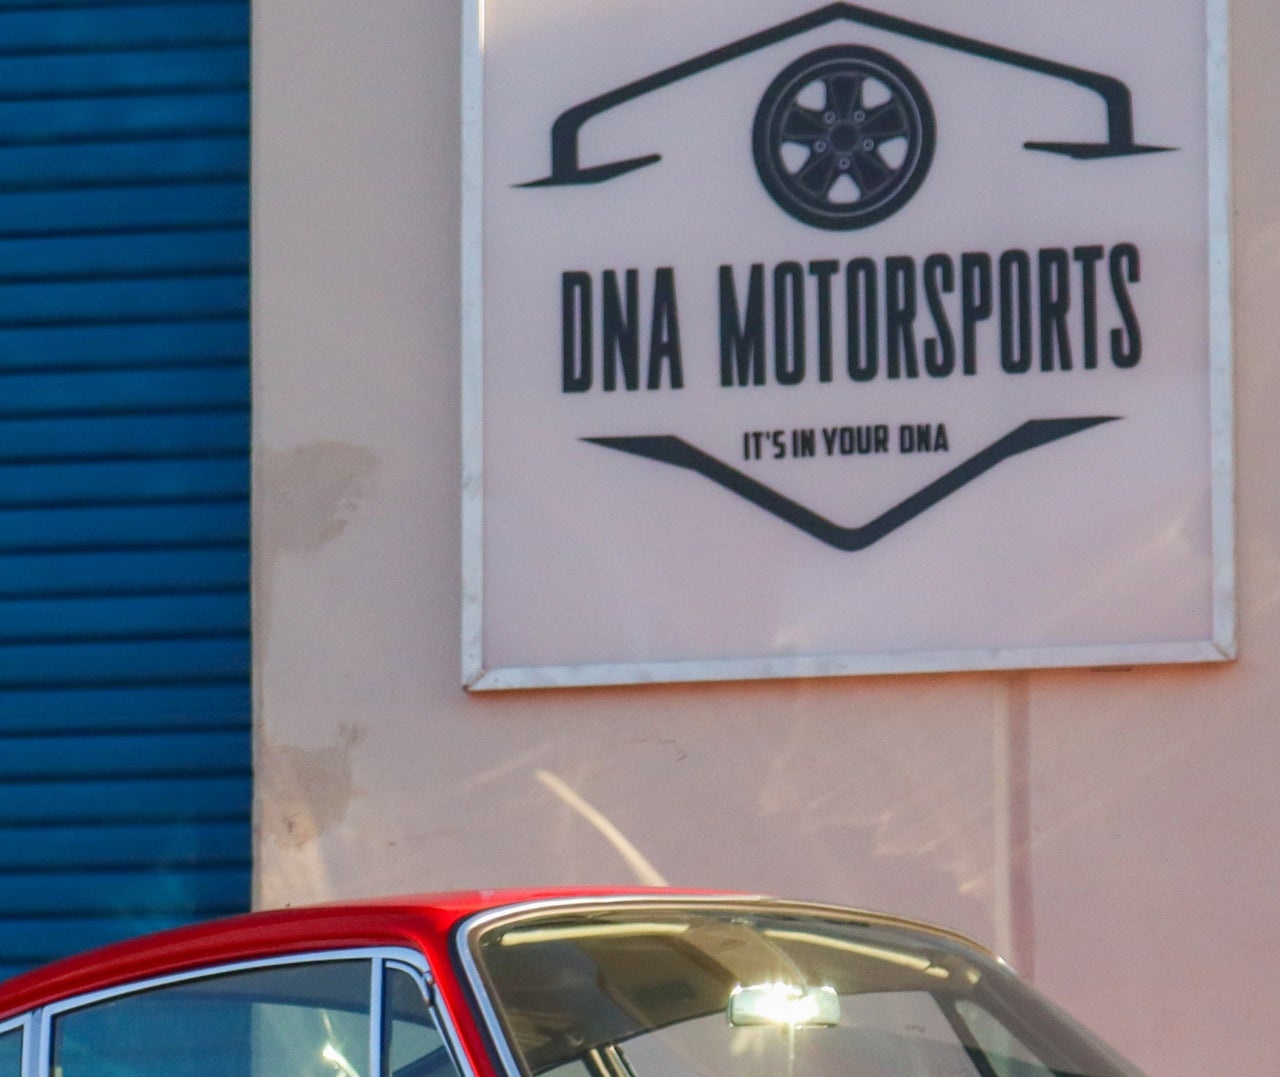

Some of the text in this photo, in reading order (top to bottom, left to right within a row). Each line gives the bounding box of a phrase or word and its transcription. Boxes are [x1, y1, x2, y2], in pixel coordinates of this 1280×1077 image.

[560, 242, 1143, 394] DNA MOTORSPORTS
[742, 422, 950, 462] IT'S IN YOUR DNA
